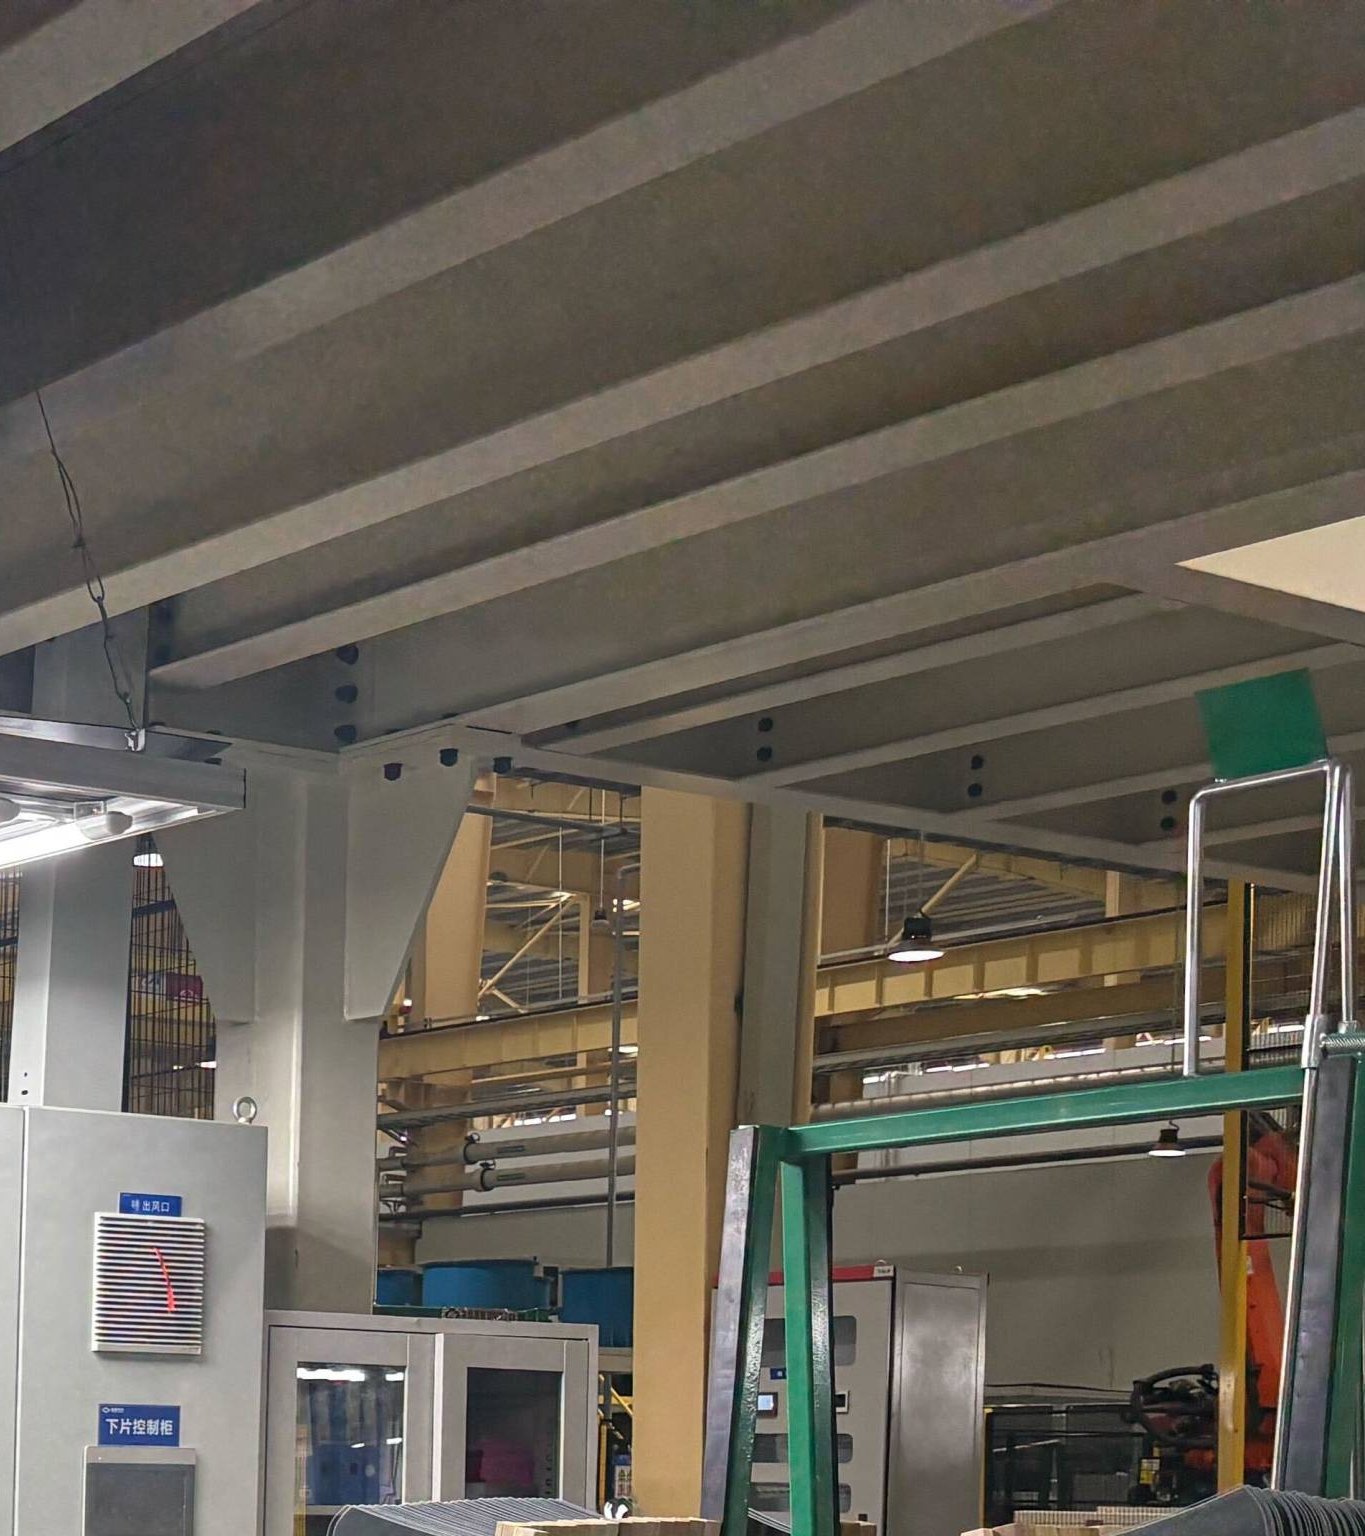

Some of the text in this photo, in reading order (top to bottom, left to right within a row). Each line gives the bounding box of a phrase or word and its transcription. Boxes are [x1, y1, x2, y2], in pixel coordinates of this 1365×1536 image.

[142, 1200, 170, 1212] 出风口
[105, 1418, 173, 1435] 下片控制柜
